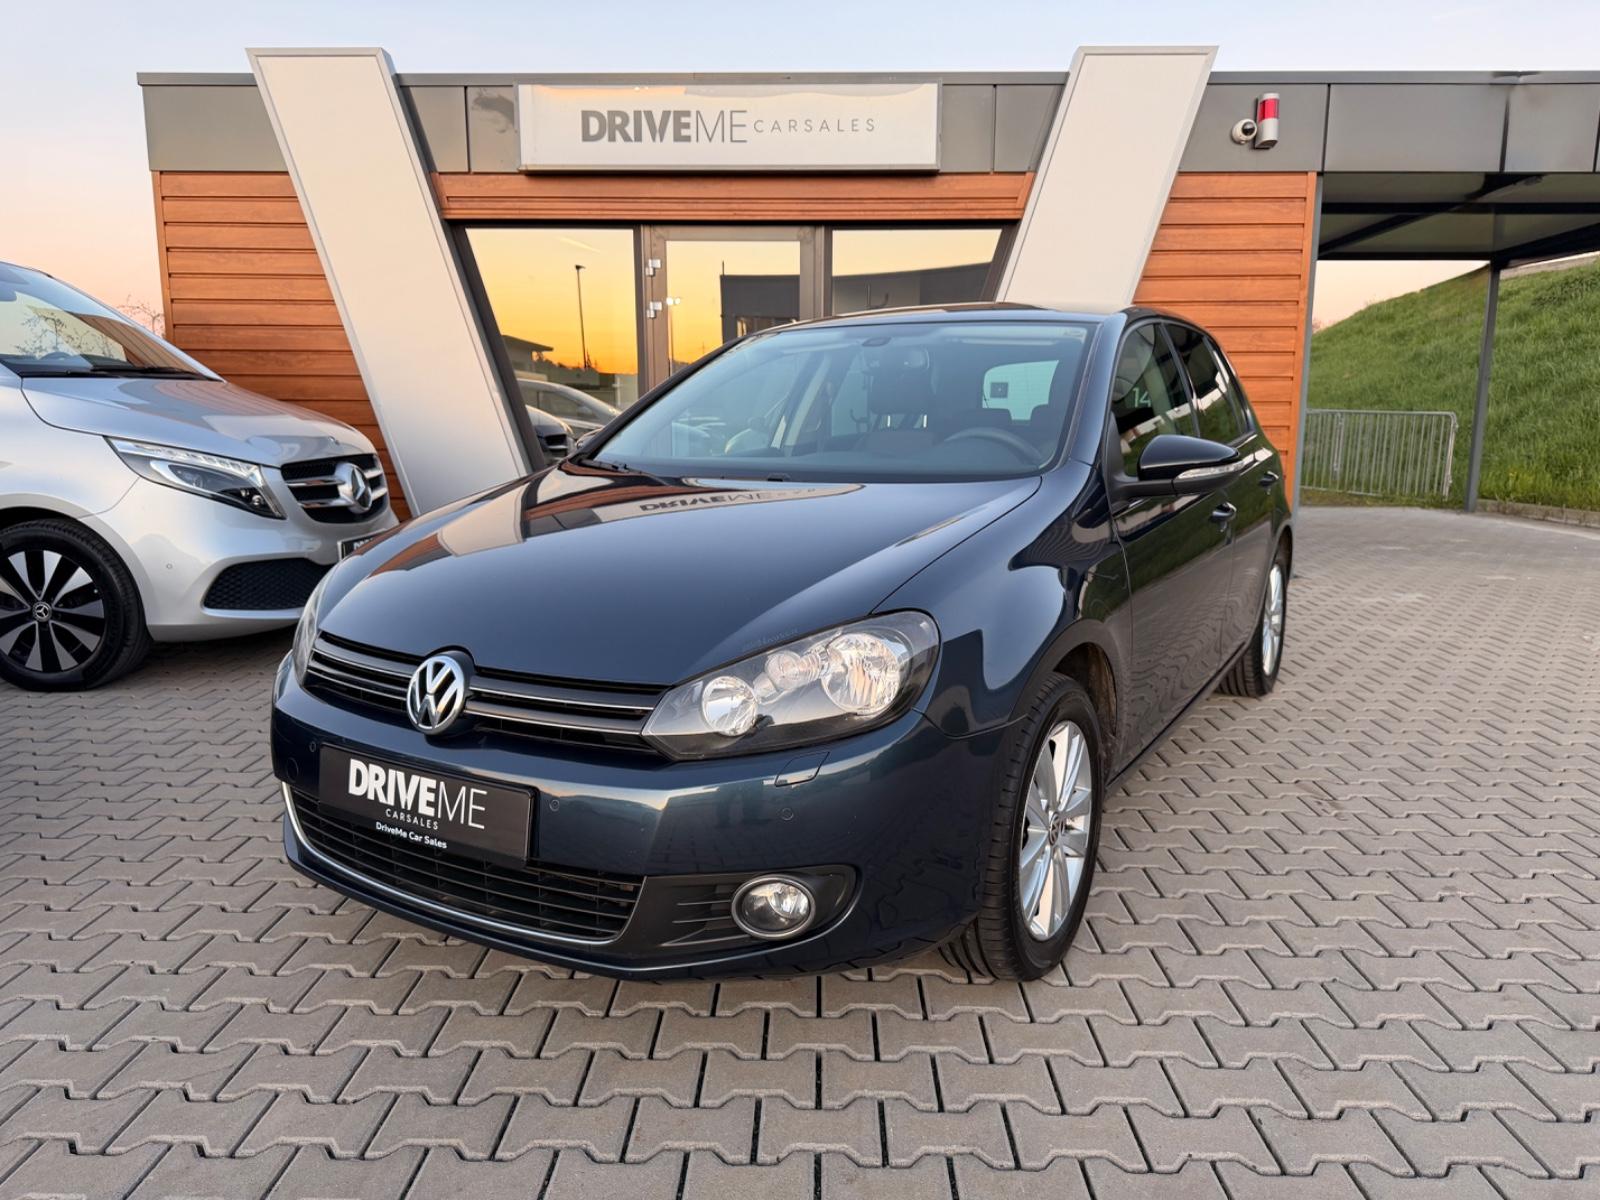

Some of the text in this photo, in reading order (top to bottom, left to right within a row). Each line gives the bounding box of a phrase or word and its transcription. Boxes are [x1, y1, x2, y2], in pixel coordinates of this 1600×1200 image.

[753, 119, 875, 133] CARSALES
[385, 808, 439, 830] CARSALES
[375, 821, 448, 849] DriveMe Car Sales
